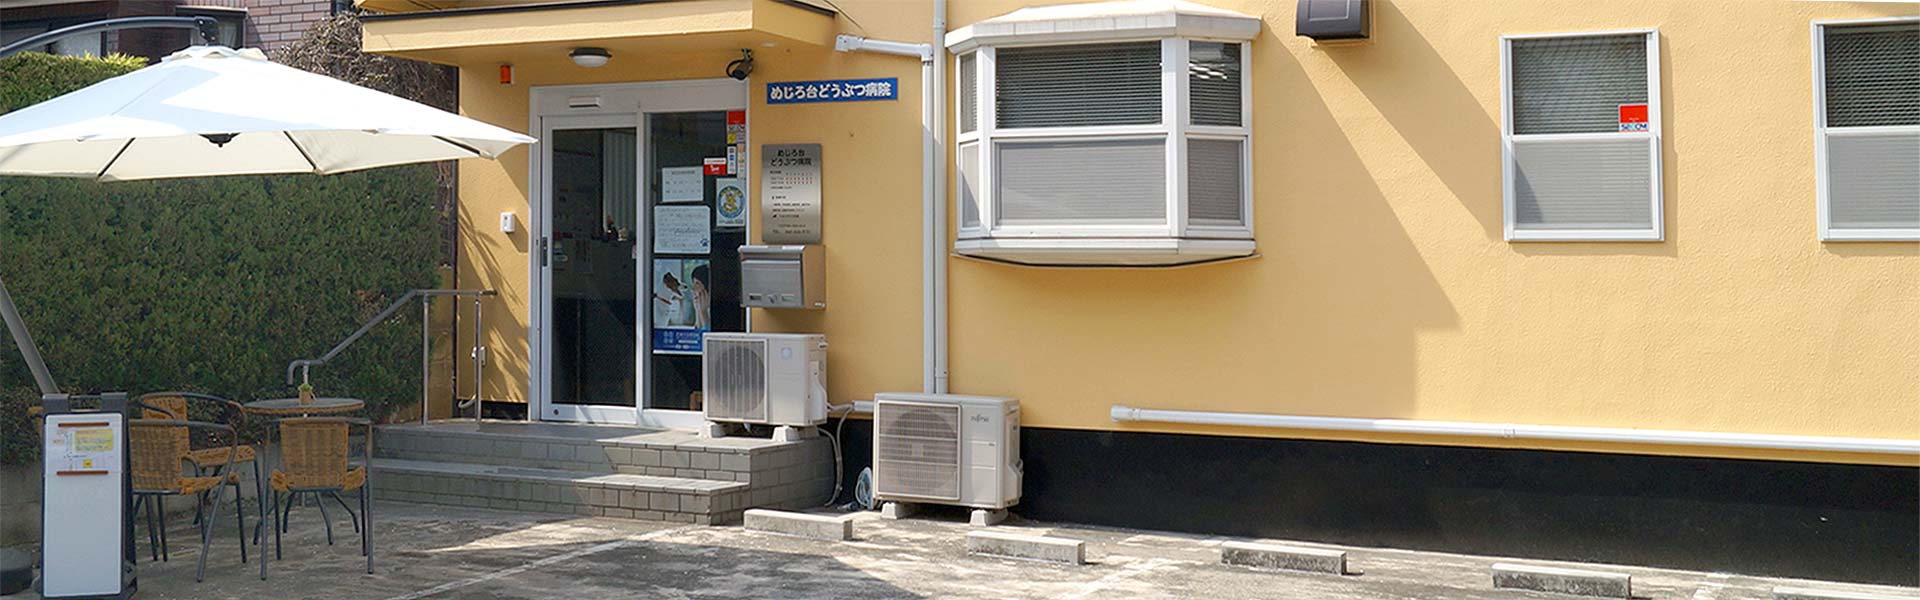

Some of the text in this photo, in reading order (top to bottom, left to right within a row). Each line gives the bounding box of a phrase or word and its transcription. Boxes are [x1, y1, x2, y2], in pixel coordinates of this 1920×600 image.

[770, 82, 892, 100] めじろ台どうぶつ病院
